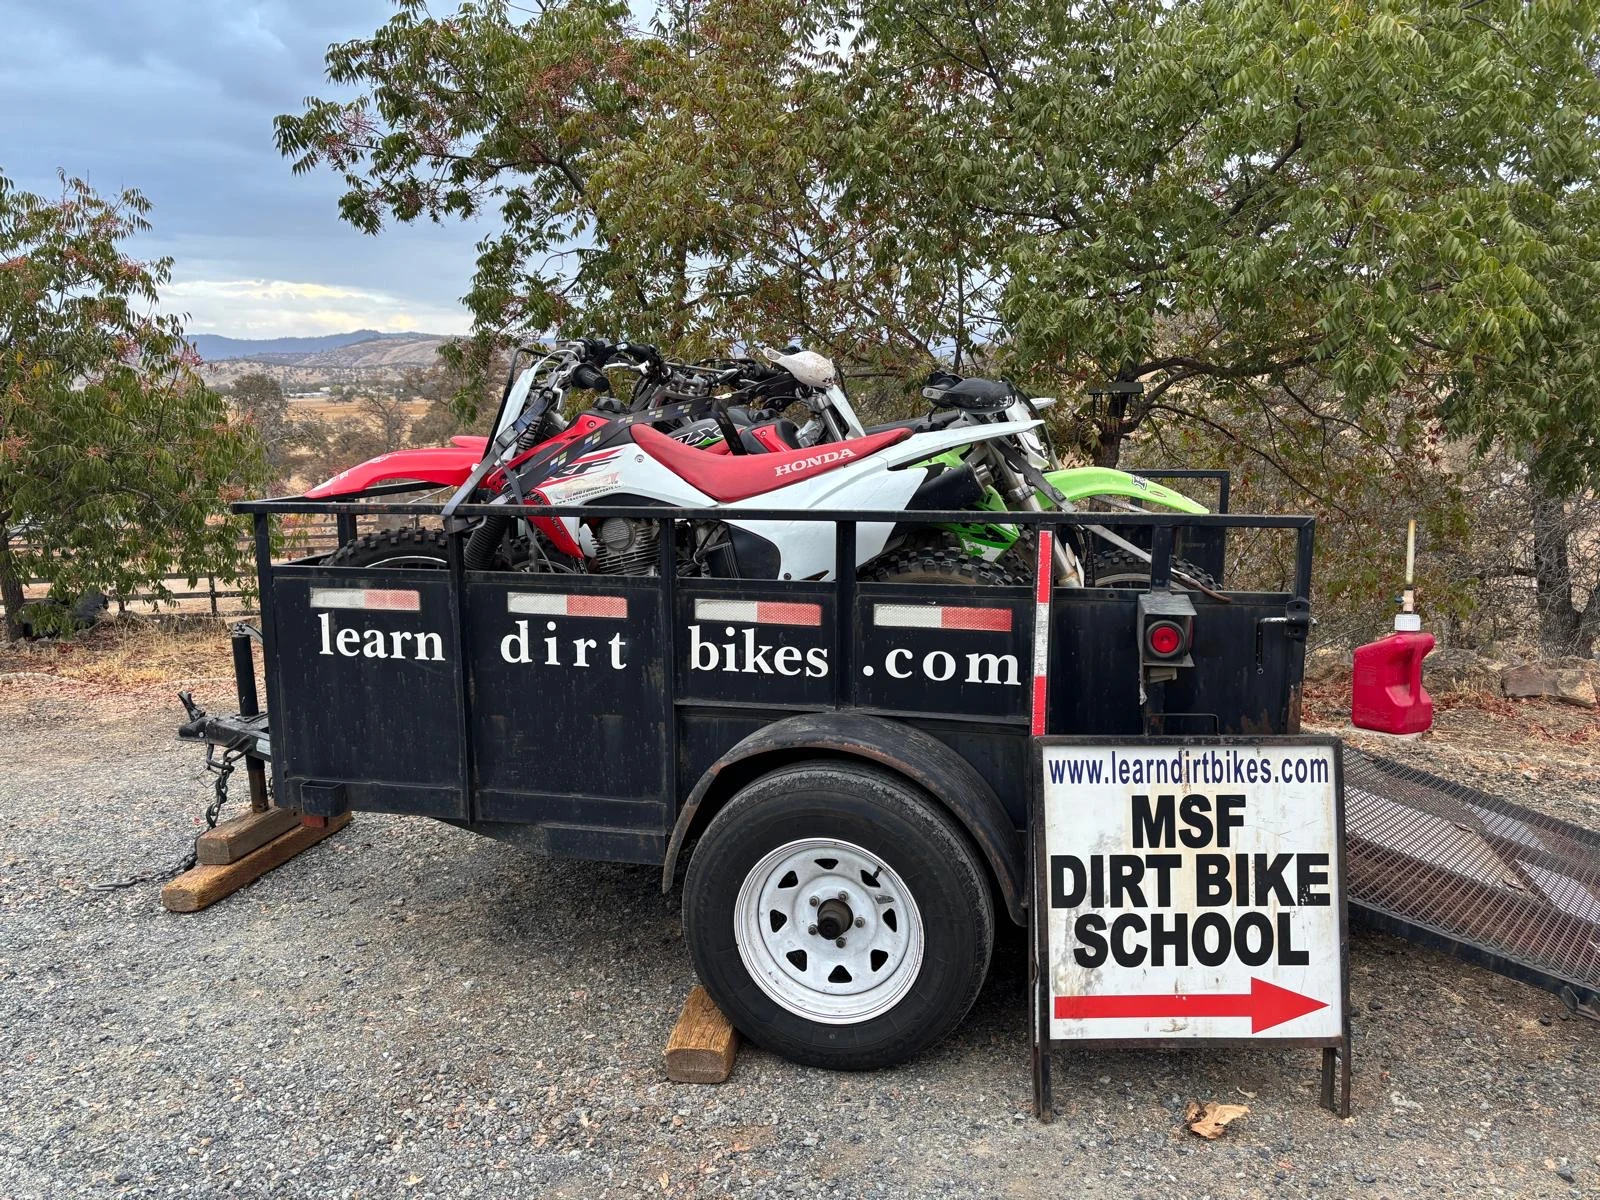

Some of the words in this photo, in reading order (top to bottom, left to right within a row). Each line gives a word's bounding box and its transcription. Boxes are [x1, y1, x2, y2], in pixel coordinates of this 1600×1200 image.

[775, 448, 856, 477] HONDA
[317, 612, 446, 662] learn
[500, 620, 627, 670] dirt
[688, 625, 829, 678] bikes
[862, 648, 1022, 686] .com
[1048, 750, 1329, 785] www.learndirtbikes.com
[1131, 794, 1247, 849] MSF
[1050, 854, 1182, 909] DIRT
[1195, 853, 1331, 907] BIKE
[1073, 911, 1310, 969] SCHOOL
